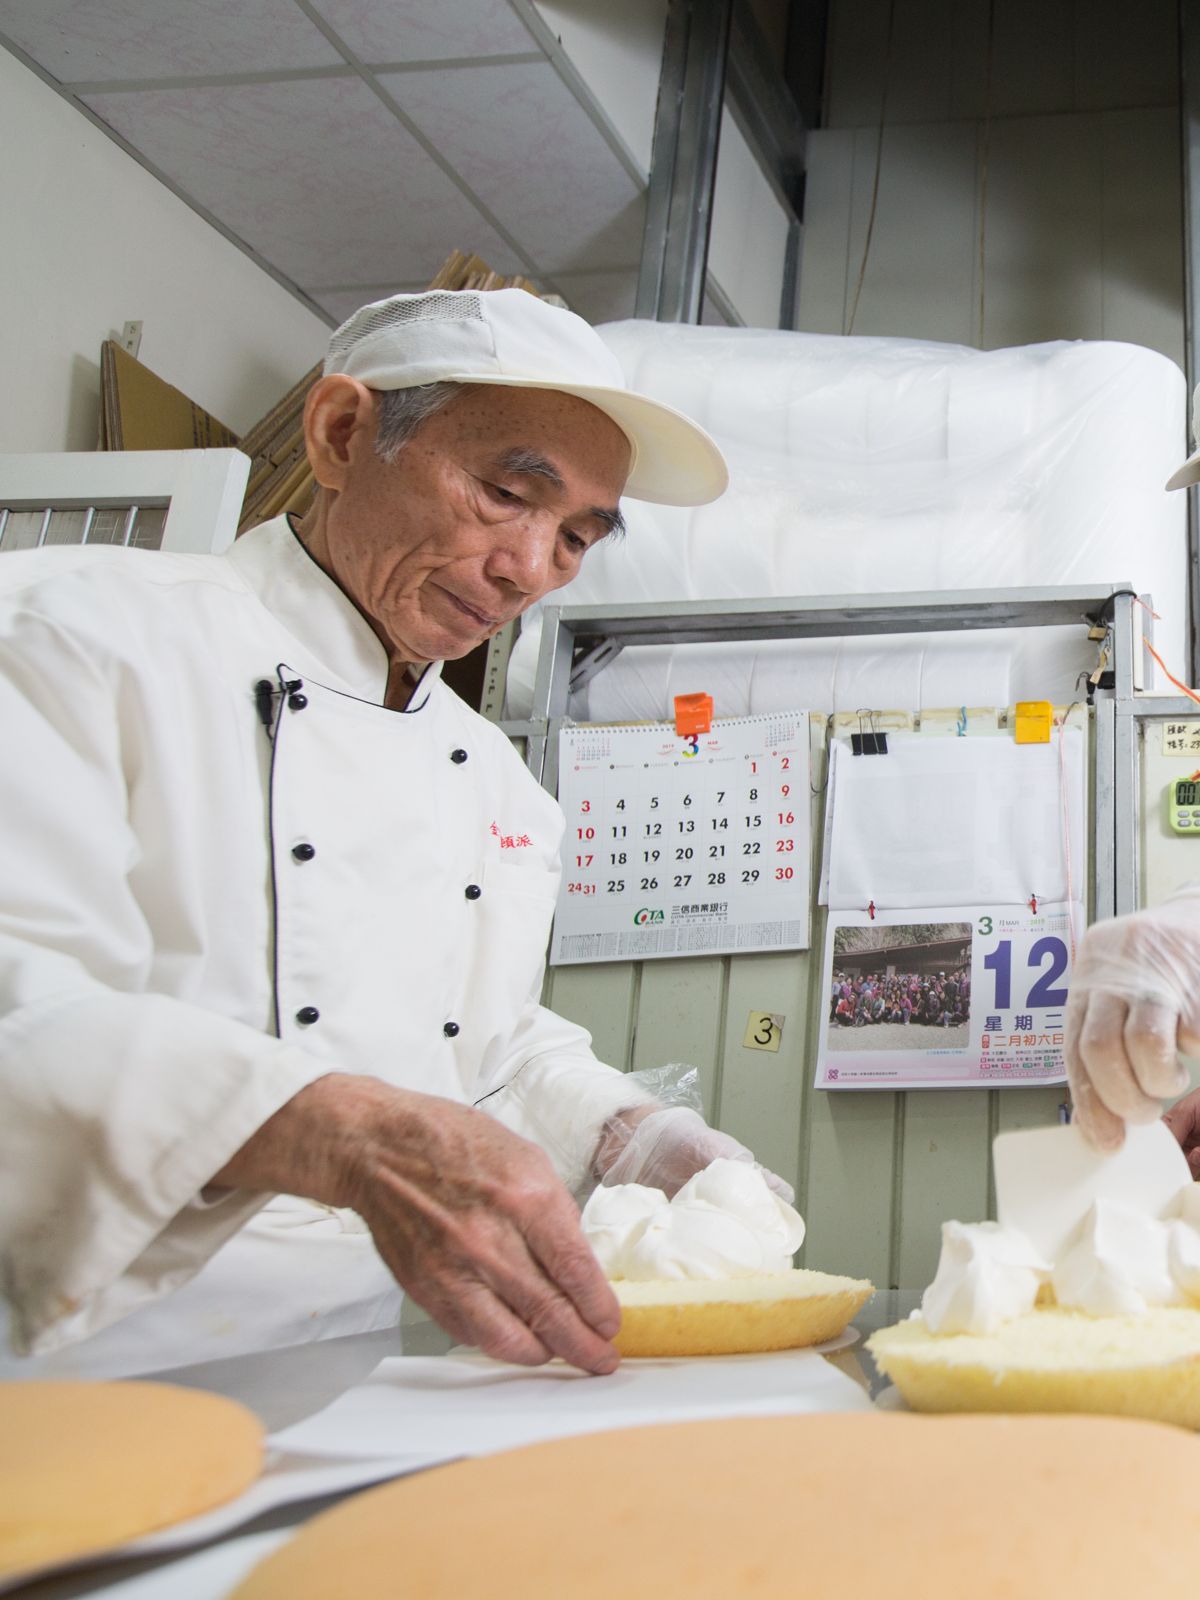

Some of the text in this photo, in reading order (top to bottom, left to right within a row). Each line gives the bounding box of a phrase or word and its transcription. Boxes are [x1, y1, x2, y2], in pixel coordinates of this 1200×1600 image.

[682, 734, 699, 758] 3
[751, 761, 757, 774] 1
[781, 757, 790, 770] 2
[581, 784, 790, 813] 3 4 5 6 7 8 9
[577, 811, 795, 840] 10 11 12 13 14 15 16
[576, 839, 794, 868] 17 18 19 20 21 22 23
[568, 867, 794, 895] 24 31 25 26 27 28 29 30
[671, 902, 728, 915] 三信商業銀行
[978, 916, 993, 936] 3
[983, 936, 1069, 1010] 12
[754, 1017, 773, 1045] 3
[983, 1013, 1063, 1032] 星期二
[994, 1033, 1064, 1047] 二月初六日
